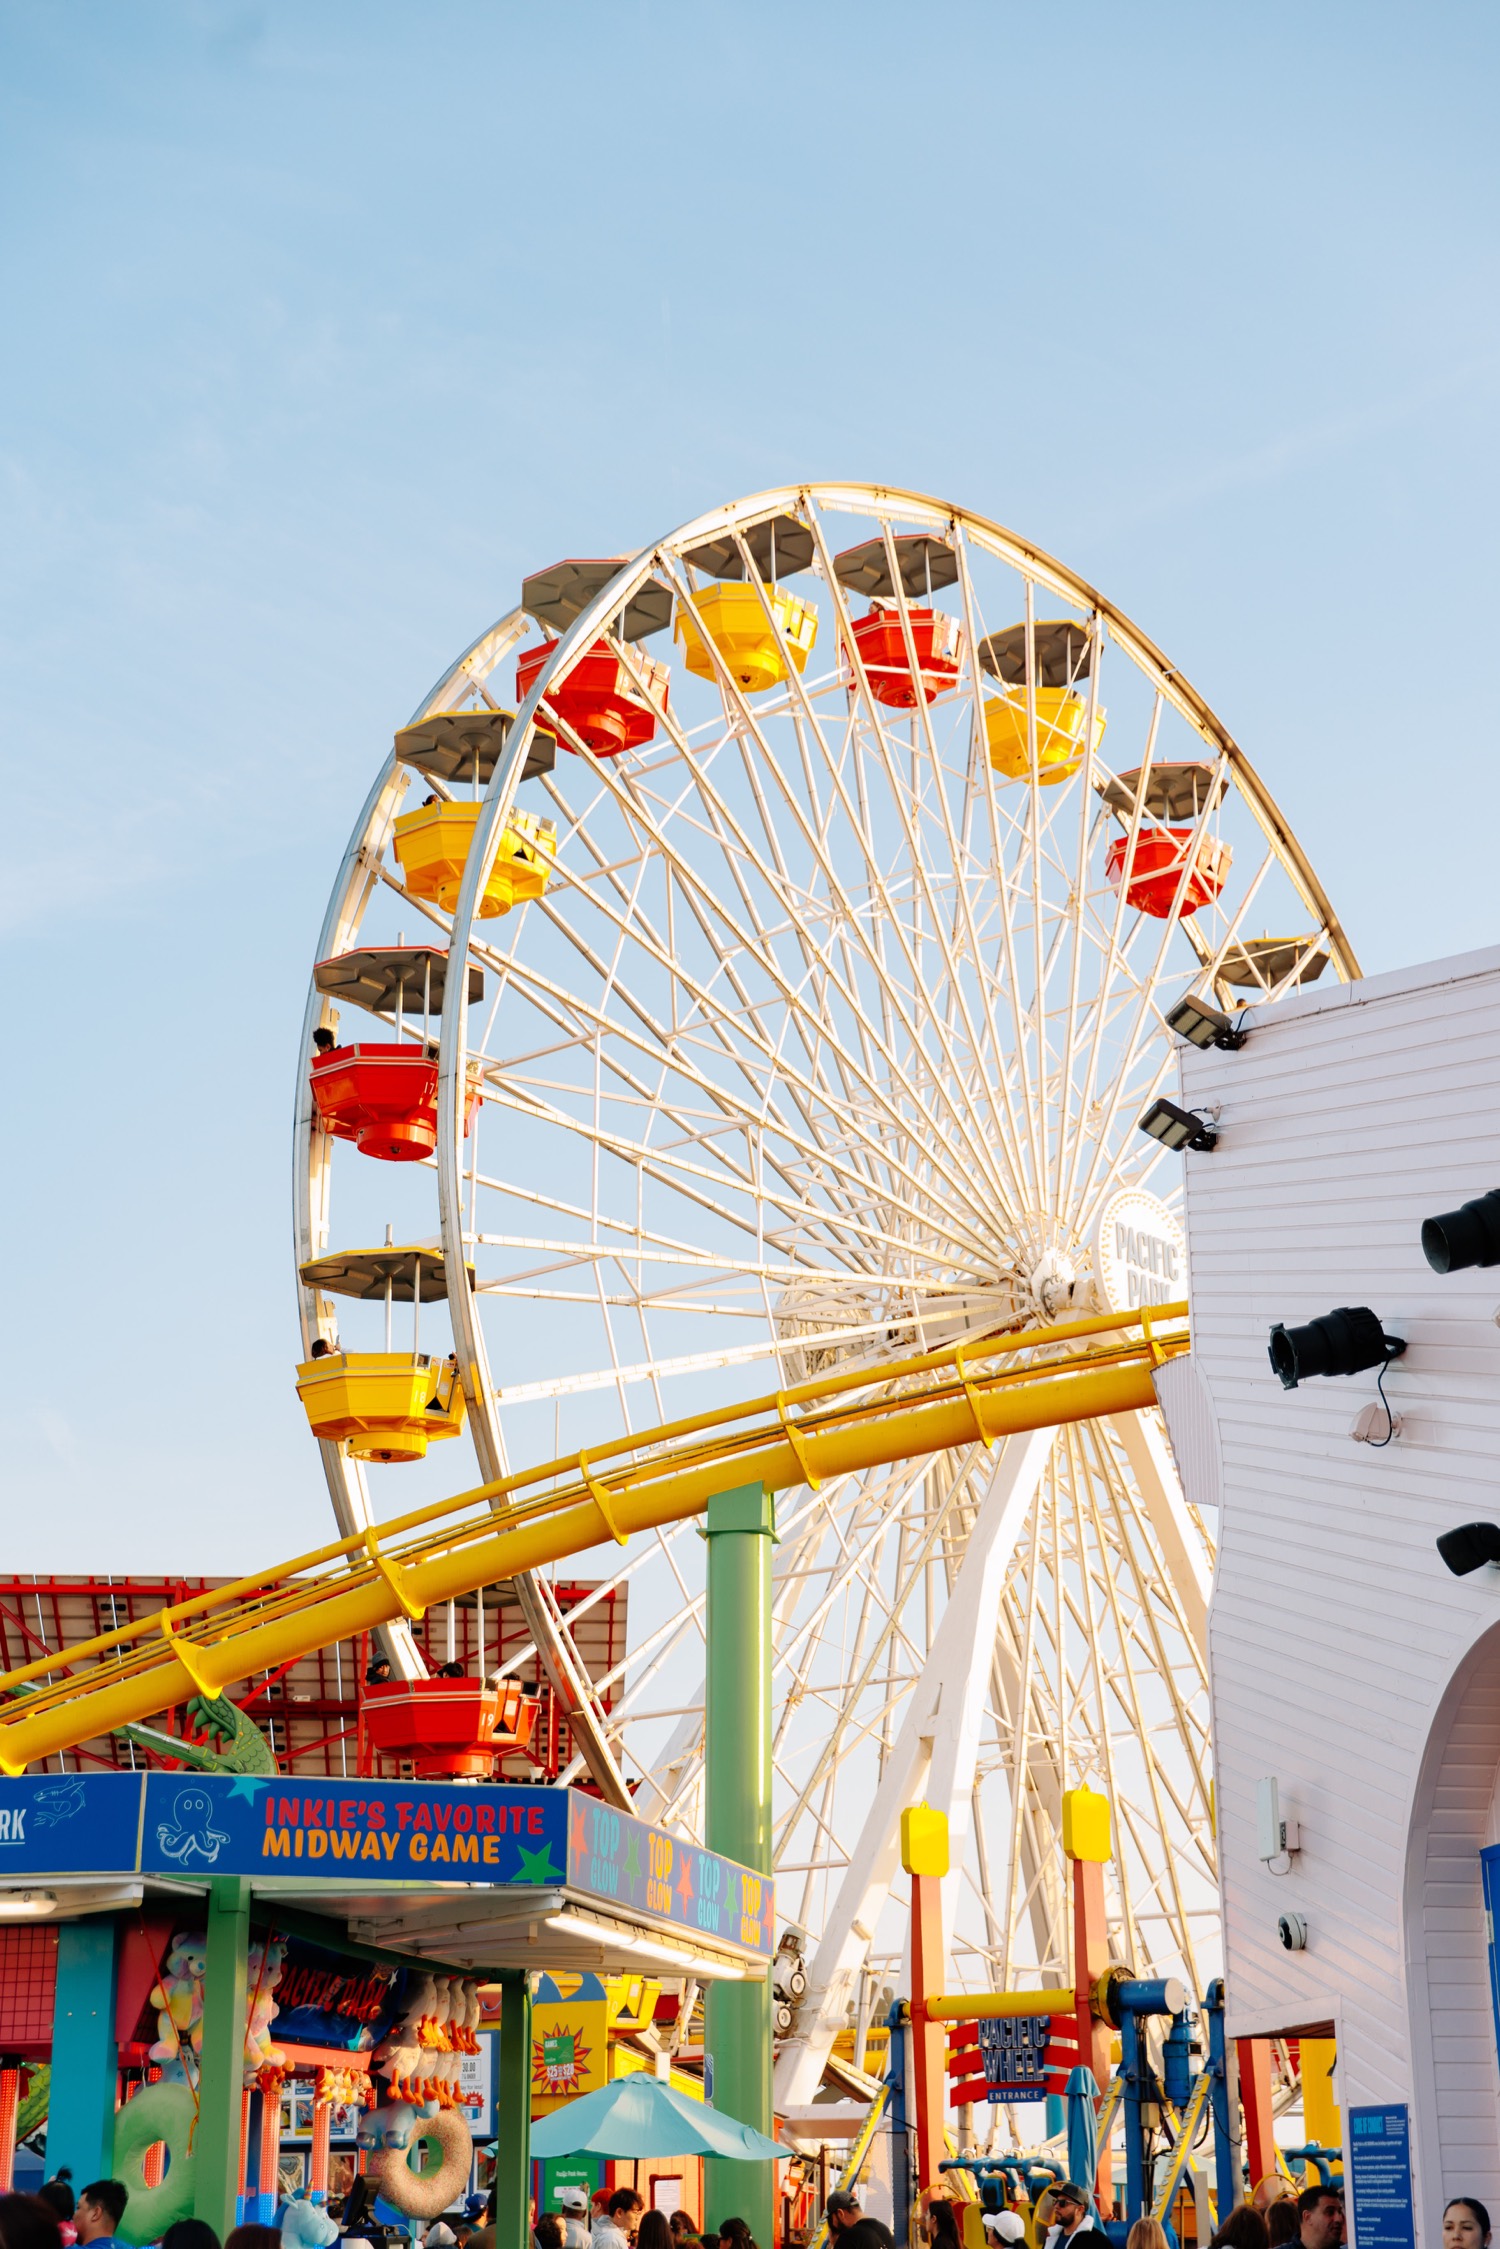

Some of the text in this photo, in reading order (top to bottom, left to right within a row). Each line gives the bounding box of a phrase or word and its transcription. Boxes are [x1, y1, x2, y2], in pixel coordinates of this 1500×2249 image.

[424, 1081, 435, 1094] 17
[1115, 1222, 1179, 1281] PACIFIC
[414, 1390, 426, 1404] 18
[481, 1713, 494, 1726] 19
[265, 1797, 544, 1834] INKIE'S FAVORITE
[592, 1807, 620, 1860] TOP
[262, 1827, 500, 1864] MIDWAY GAME
[648, 1832, 673, 1883] TOP
[590, 1855, 619, 1896] GLOW
[698, 1853, 720, 1901] TOP
[646, 1877, 673, 1915] GLOW
[741, 1873, 761, 1918] TOP
[697, 1897, 720, 1932] GLOW
[741, 1914, 761, 1947] GLOW
[978, 2016, 1046, 2048] PACIFIC
[981, 2048, 1044, 2082] WHEEL
[989, 2090, 1040, 2101] ENTRANCE
